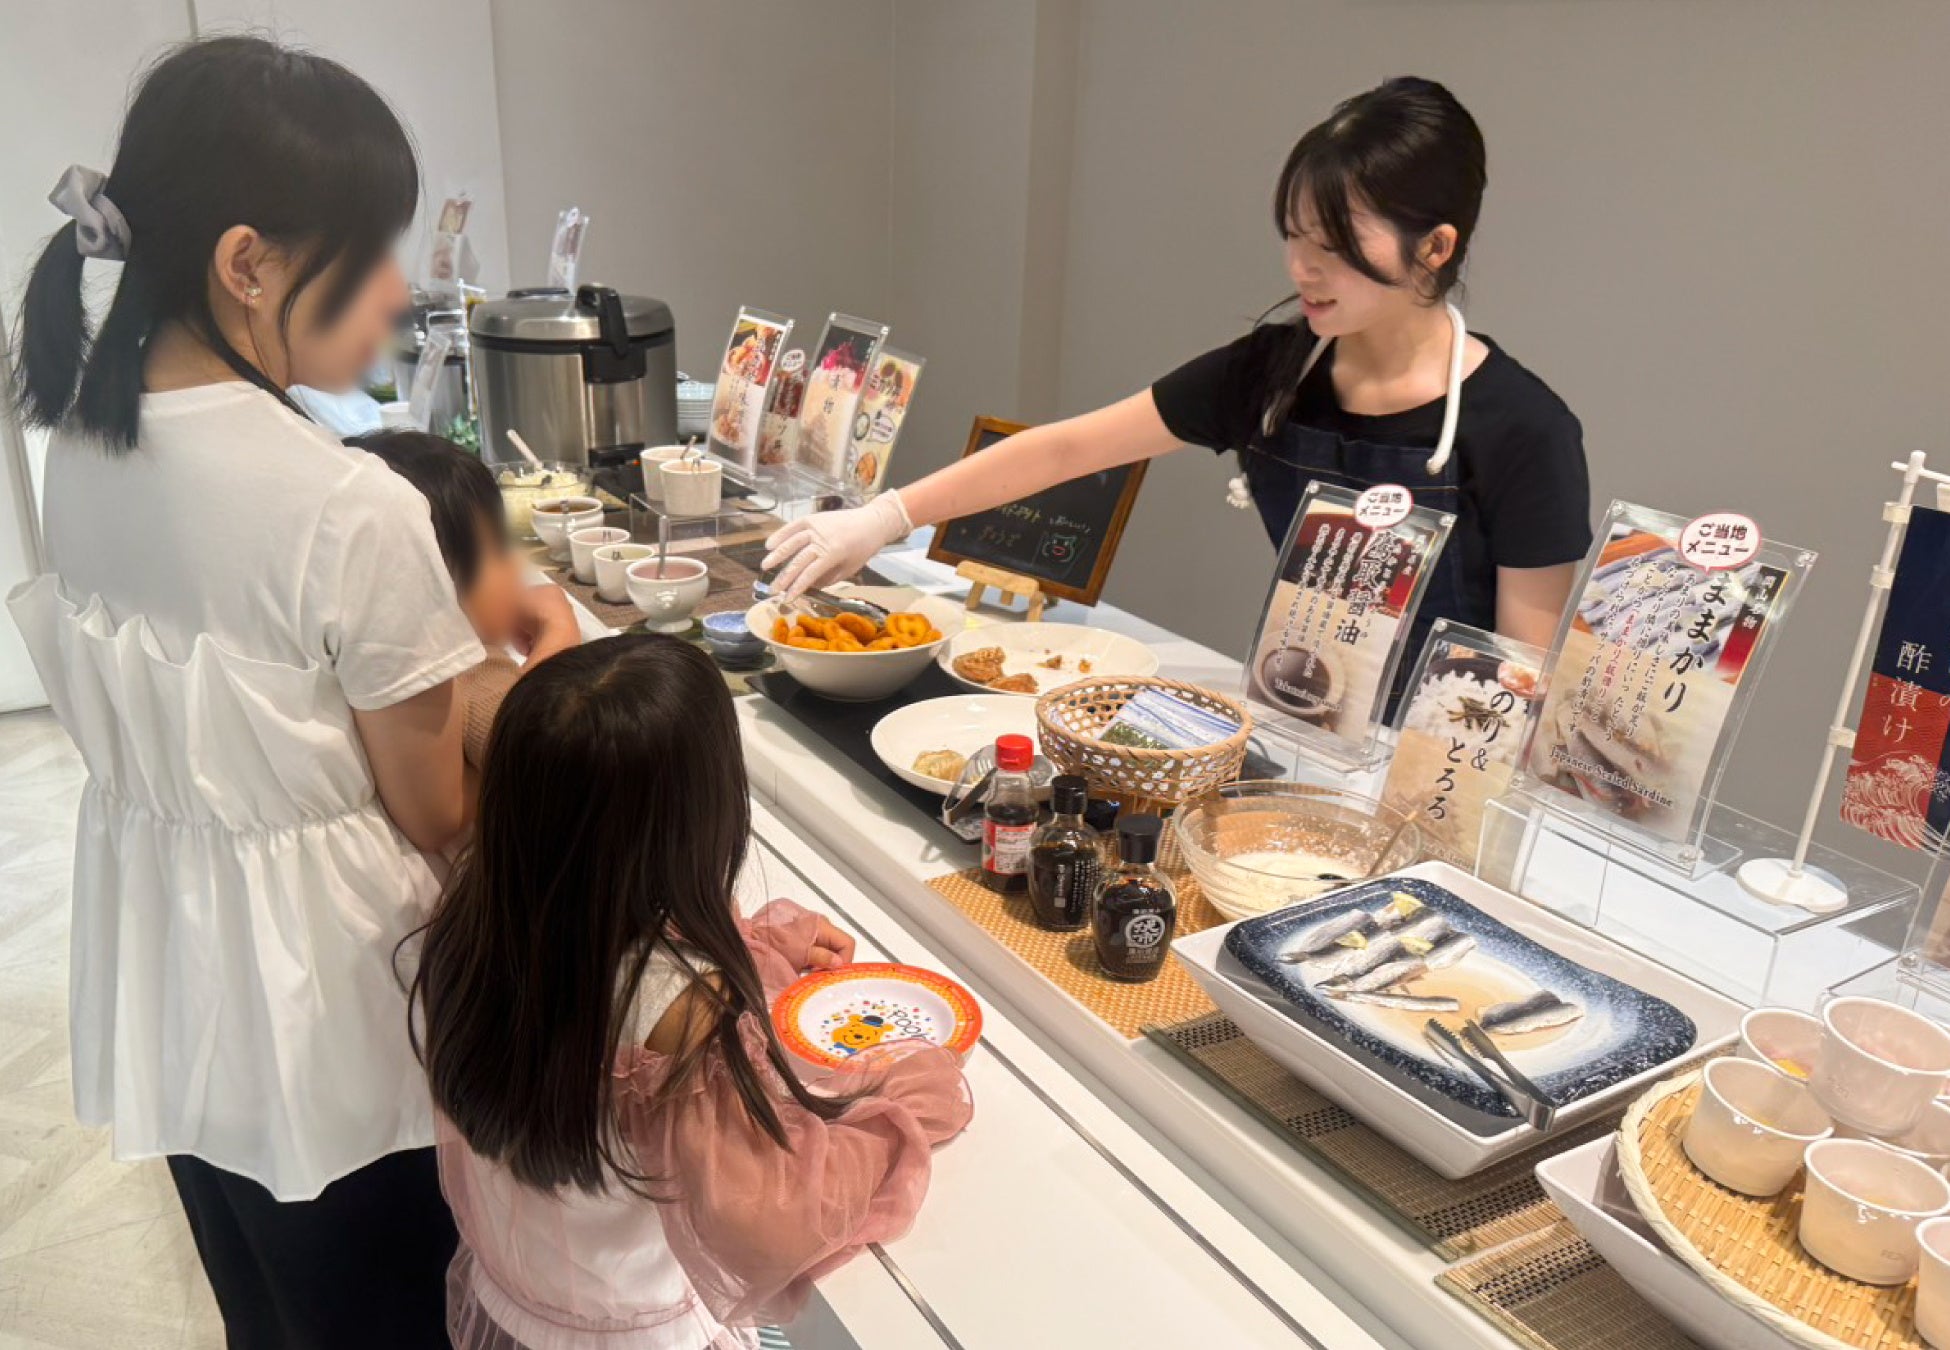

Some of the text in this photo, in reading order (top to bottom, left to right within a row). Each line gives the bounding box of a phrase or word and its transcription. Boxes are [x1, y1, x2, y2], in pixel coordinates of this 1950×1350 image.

[1685, 540, 1750, 556] メニュー
[1698, 522, 1748, 541] ご当地
[1664, 572, 1731, 713] ままかり
[1882, 640, 1933, 743] 酢漬け
[1426, 736, 1465, 820] とろろ
[1631, 778, 1674, 808] Sardine
